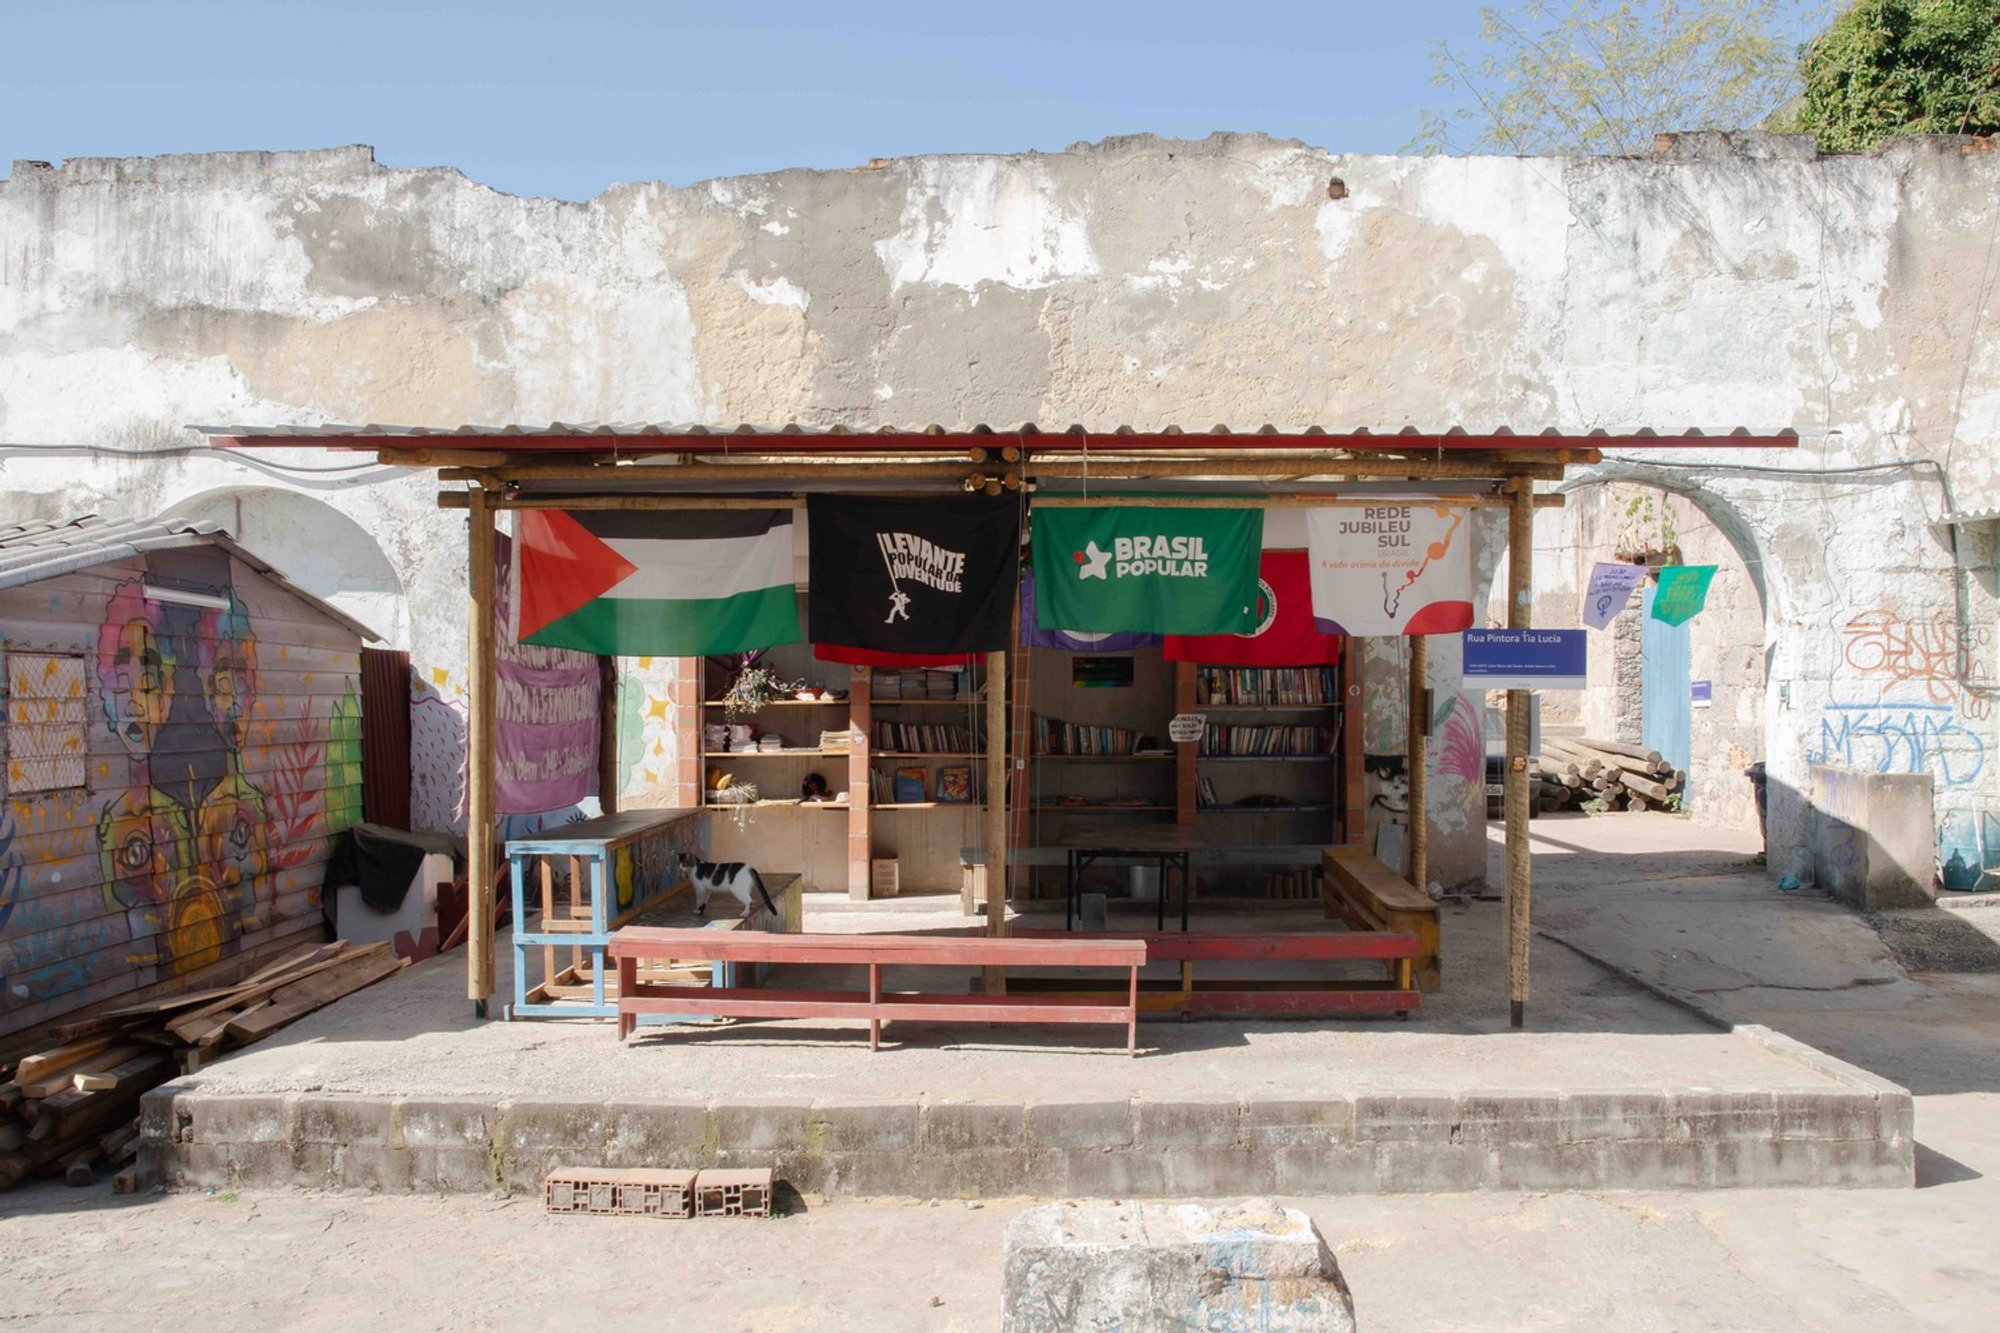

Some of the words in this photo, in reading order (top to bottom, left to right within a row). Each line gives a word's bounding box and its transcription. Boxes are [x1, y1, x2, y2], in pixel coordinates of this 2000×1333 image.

[1364, 507, 1411, 519] REDE
[1339, 520, 1411, 534] JUBILEU
[1115, 535, 1208, 560] BRASIL
[1378, 535, 1411, 547] SUL
[882, 533, 965, 573] LEVANTE
[1378, 550, 1409, 558] BRASIL
[890, 552, 943, 581] POPULAR
[945, 571, 961, 583] DA
[1116, 559, 1208, 578] POPULAR
[1329, 560, 1348, 569] vida
[893, 563, 962, 593] JUVENTUDE
[1467, 634, 1485, 643] Rua
[1487, 634, 1519, 643] Pintora
[1523, 634, 1536, 643] Tia
[495, 678, 529, 724] NTRA
